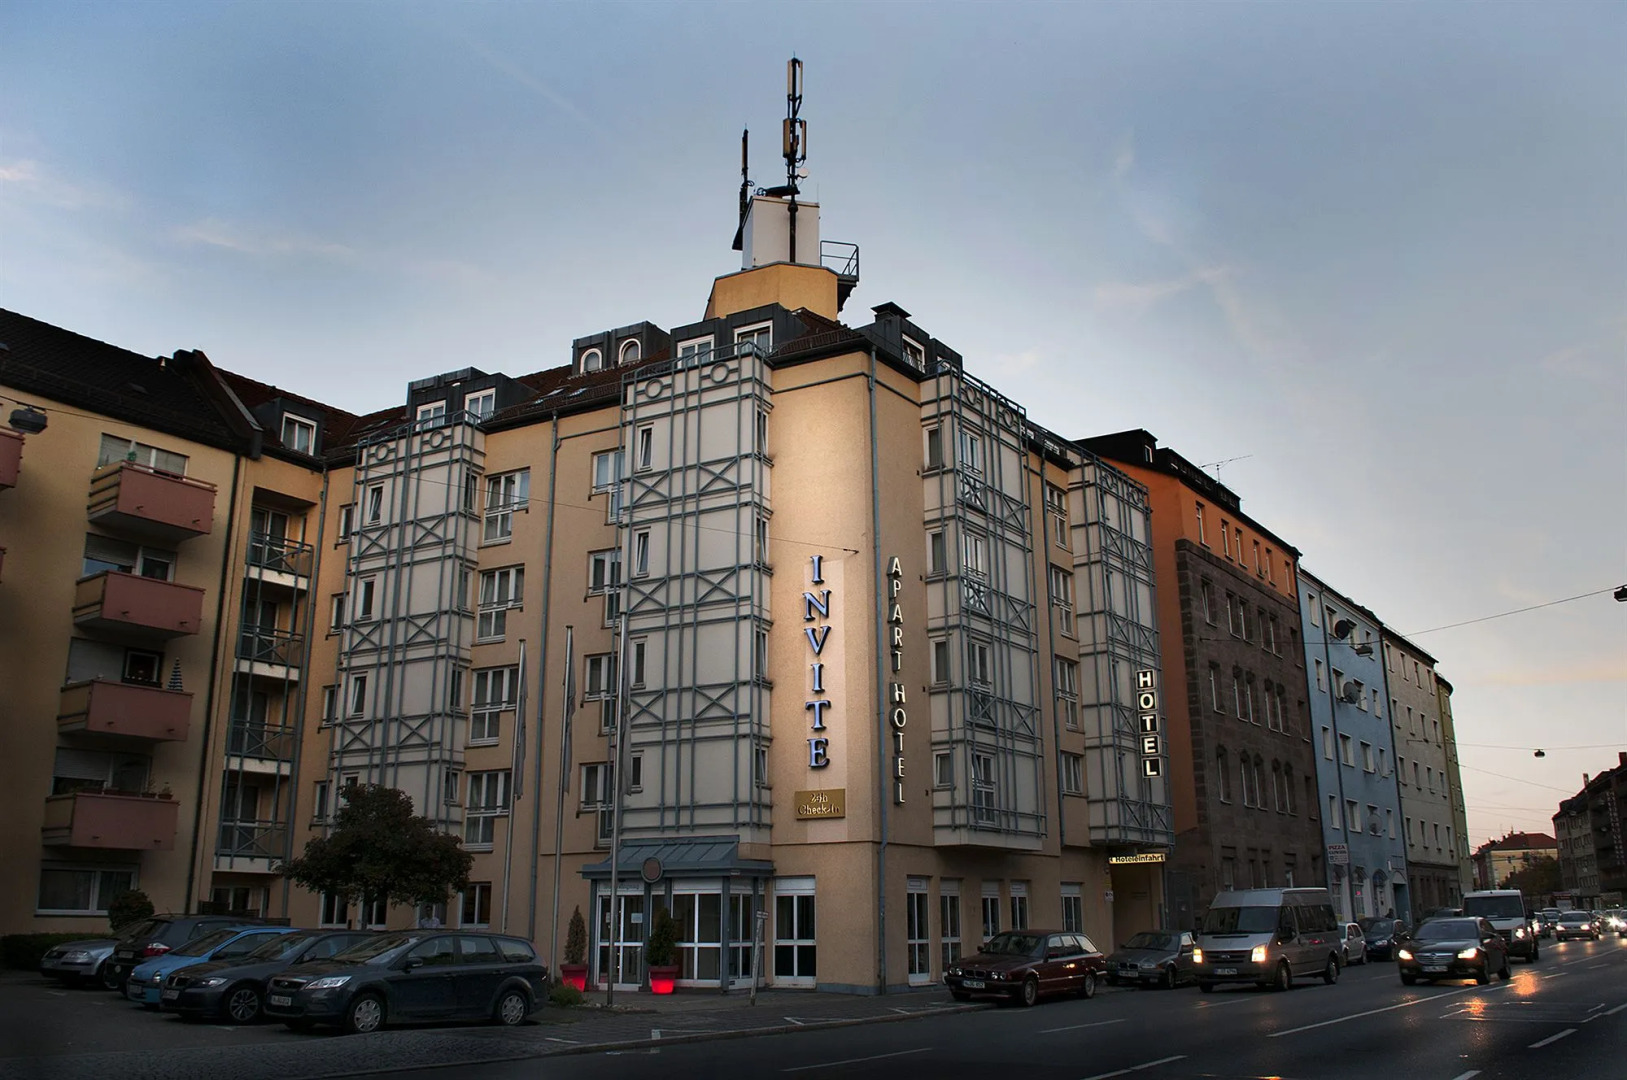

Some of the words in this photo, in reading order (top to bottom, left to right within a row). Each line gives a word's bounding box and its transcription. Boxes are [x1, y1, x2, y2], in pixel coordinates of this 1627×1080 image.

[803, 554, 832, 769] INVITE
[890, 556, 903, 672] APART
[891, 683, 907, 803] HOTEL
[1138, 671, 1158, 776] HOTEL
